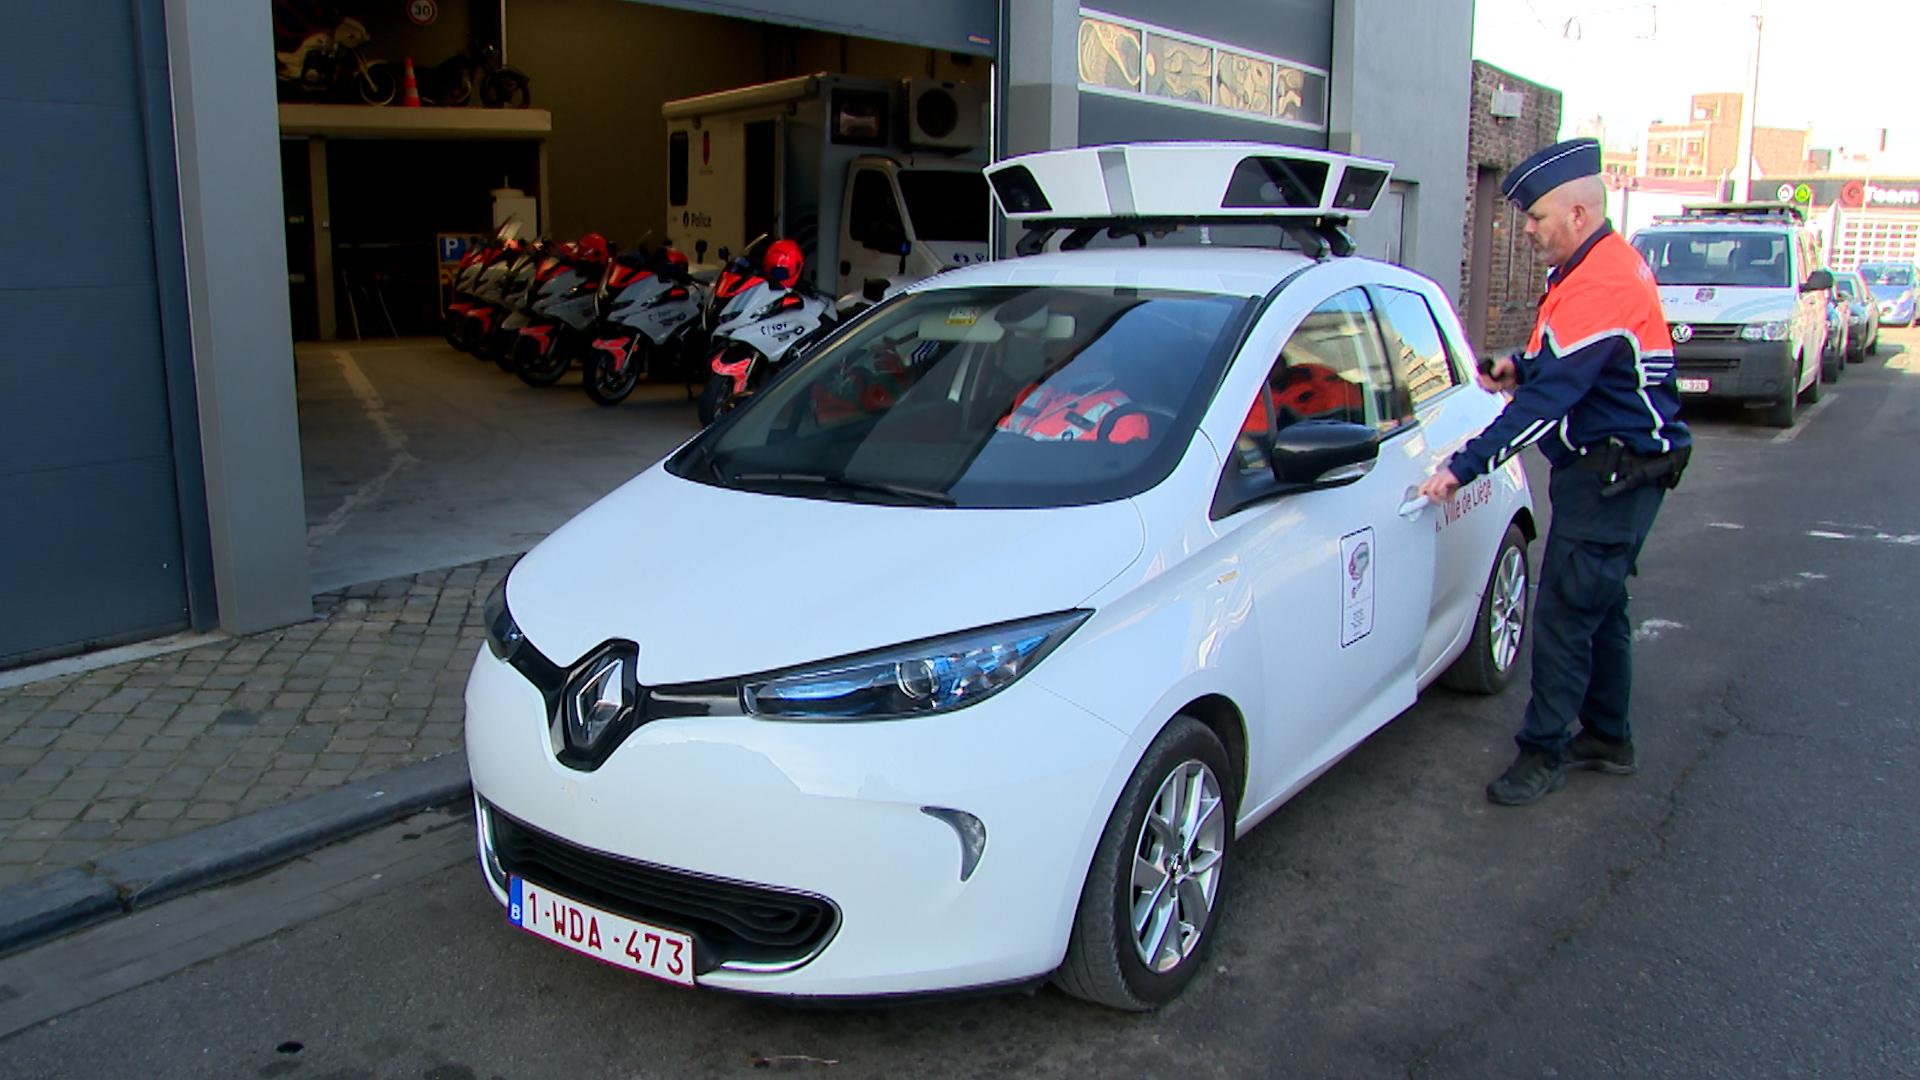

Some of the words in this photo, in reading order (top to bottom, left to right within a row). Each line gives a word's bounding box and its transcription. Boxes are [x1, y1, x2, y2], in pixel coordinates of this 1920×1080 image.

[414, 5, 431, 16] 30
[445, 238, 459, 258] P
[1443, 499, 1461, 526] Ville
[1462, 489, 1472, 515] de
[511, 904, 521, 920] B
